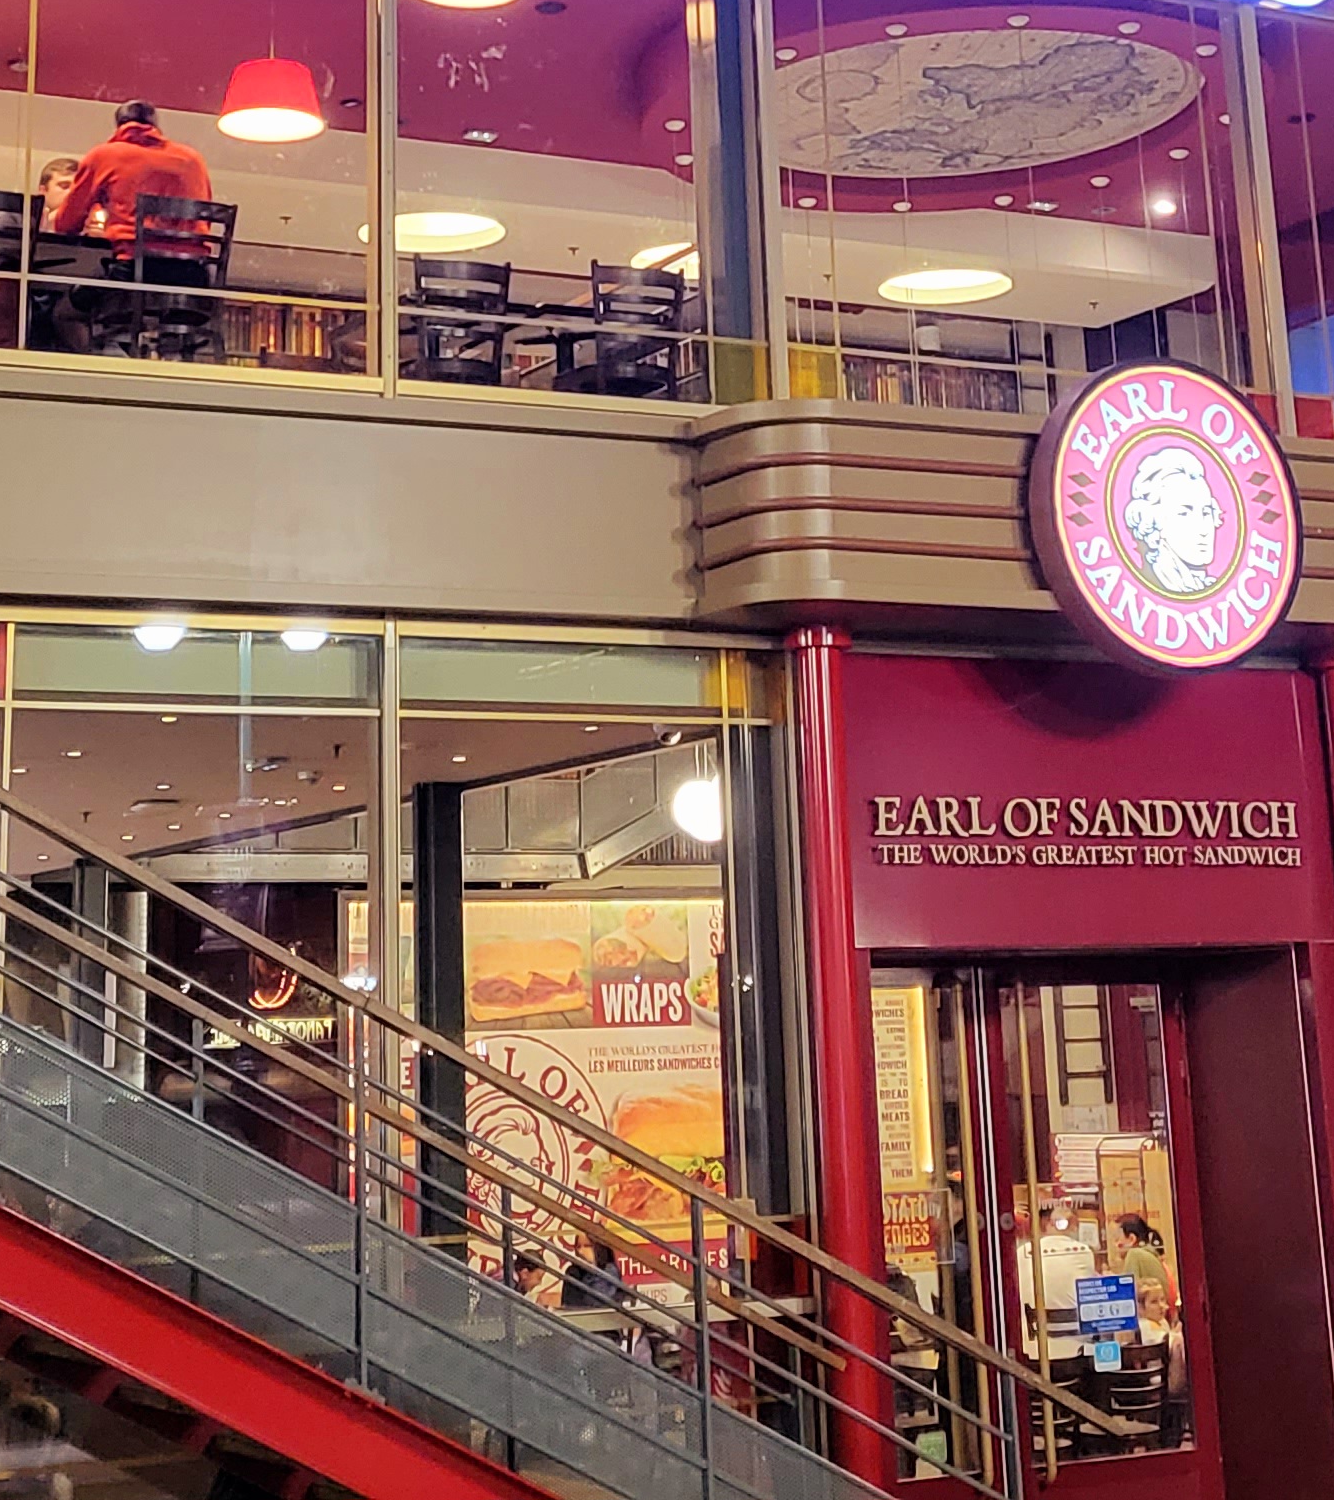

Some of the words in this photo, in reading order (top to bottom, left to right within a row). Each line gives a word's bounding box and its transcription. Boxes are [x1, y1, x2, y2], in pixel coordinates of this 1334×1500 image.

[1071, 379, 1189, 471] EARL
[1200, 403, 1261, 466] OF
[1075, 529, 1283, 651] SANDWICH
[873, 796, 996, 838] EARL
[1003, 797, 1062, 839] OF
[1069, 798, 1298, 839] SANDWICH
[878, 844, 923, 865] THE
[928, 844, 1026, 865] WORLD'S
[1032, 845, 1137, 866] GREATEST
[1144, 846, 1187, 866] HOT
[1193, 845, 1302, 867] SANDWICH
[600, 981, 684, 1025] WRAPS
[873, 1008, 905, 1018] WICHES
[589, 1046, 607, 1057] THE
[588, 1060, 605, 1074] LES
[607, 1058, 655, 1073] MEILLEURS
[657, 1056, 712, 1071] SANDWICHES
[879, 1089, 909, 1100] BREAD
[881, 1111, 910, 1122] MEATS
[881, 1140, 911, 1153] FAMILY
[883, 1193, 929, 1225] OTATO
[884, 1223, 931, 1247] EDGES
